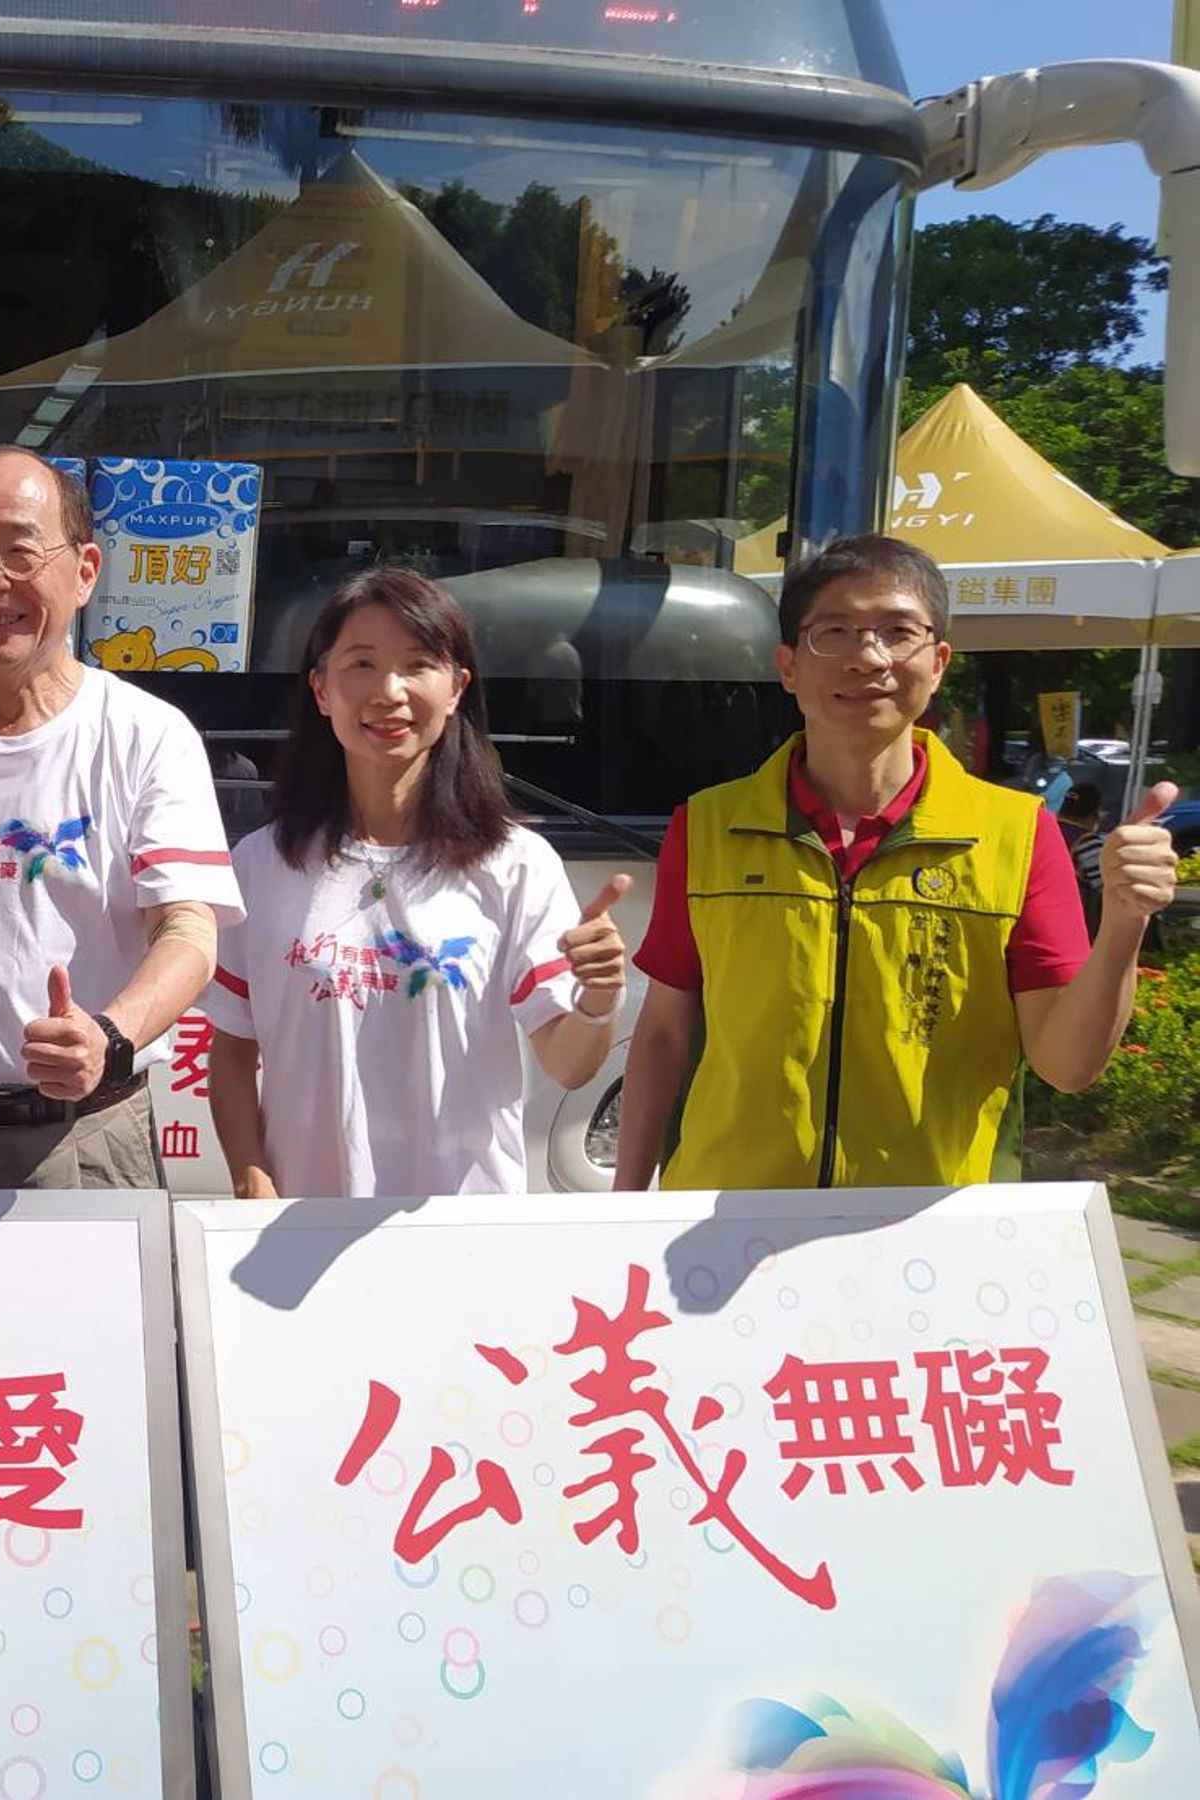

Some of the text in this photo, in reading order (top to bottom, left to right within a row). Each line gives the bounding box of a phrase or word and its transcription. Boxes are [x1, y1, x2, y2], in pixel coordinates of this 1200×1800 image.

[128, 513, 221, 528] MAXPURE
[128, 543, 212, 586] 頂好
[947, 575, 1058, 606] 鎰集團
[160, 1119, 201, 1158] 血
[333, 1262, 1076, 1611] 公義無礙
